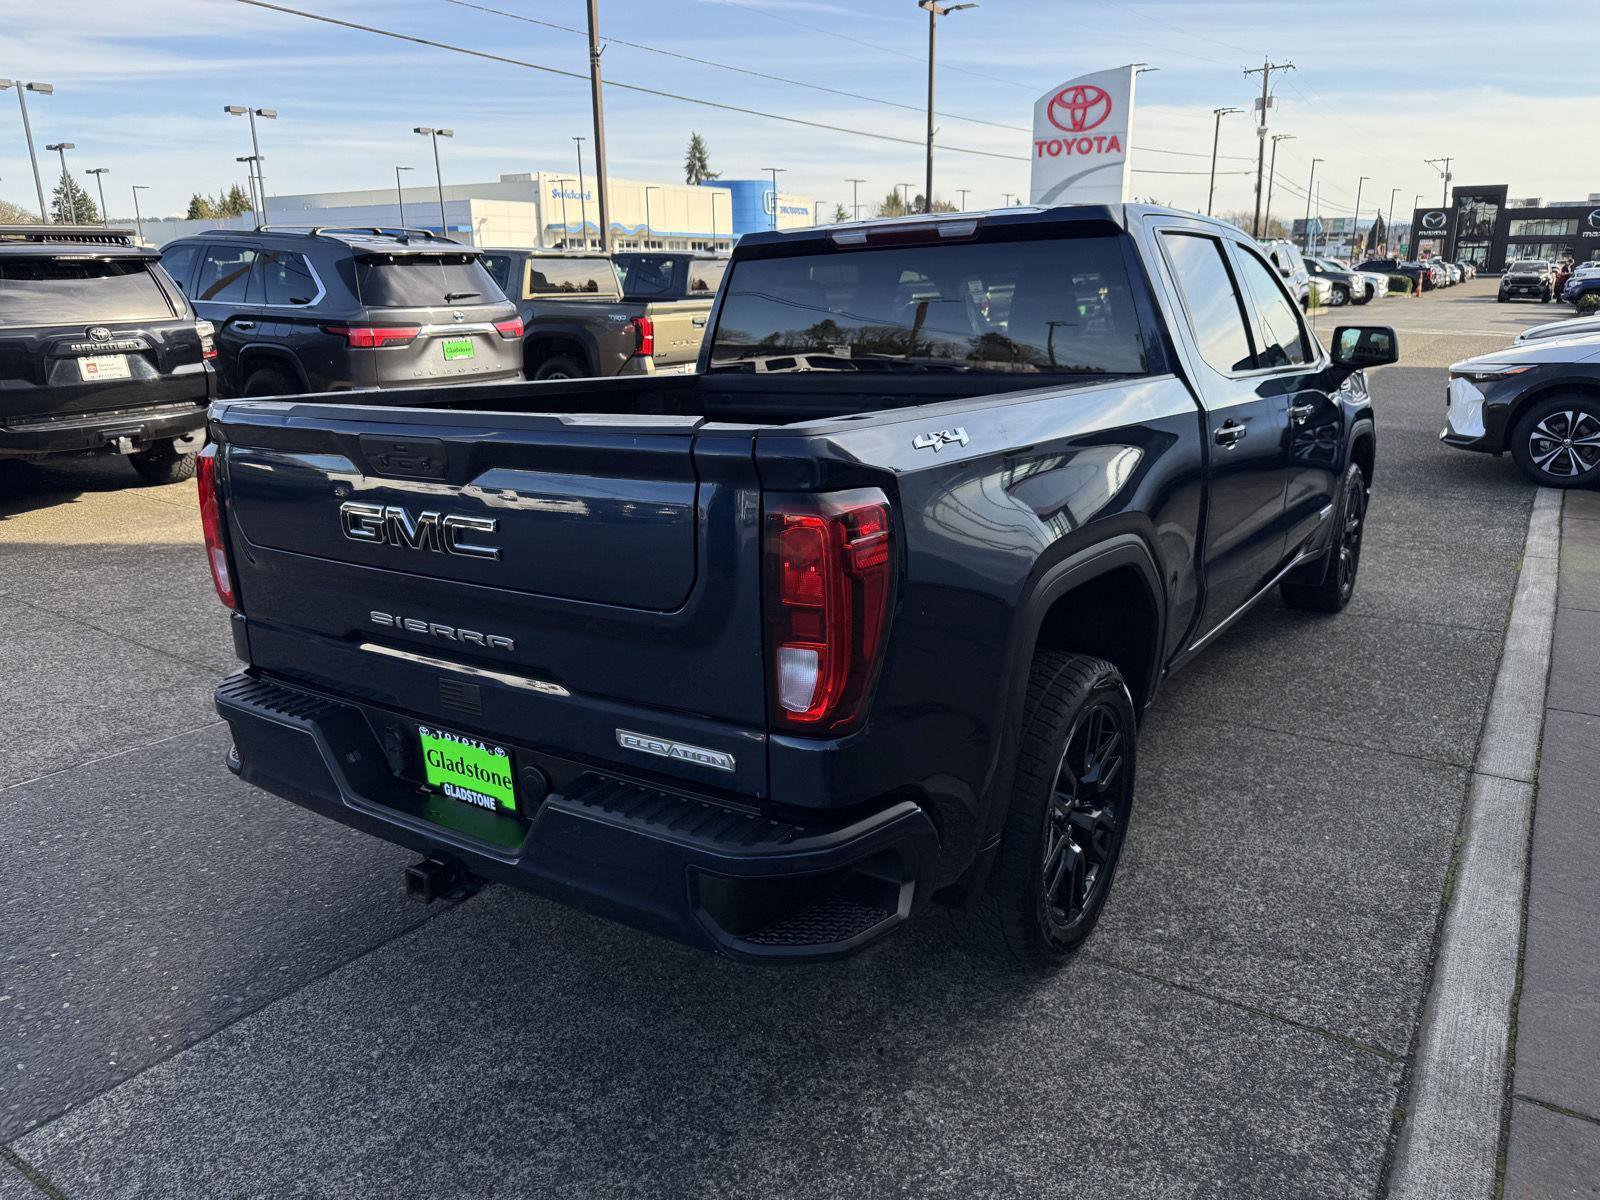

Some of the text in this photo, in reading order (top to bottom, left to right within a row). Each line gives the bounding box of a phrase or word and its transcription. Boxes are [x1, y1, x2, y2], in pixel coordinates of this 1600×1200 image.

[1035, 135, 1121, 158] TOYOTA
[340, 500, 503, 561] GMC
[369, 610, 516, 652] SIERRA
[435, 729, 487, 752] TOYOTA
[624, 735, 726, 767] ELEVATION
[426, 748, 514, 790] Gladstone
[443, 783, 498, 811] GLADSTONE
